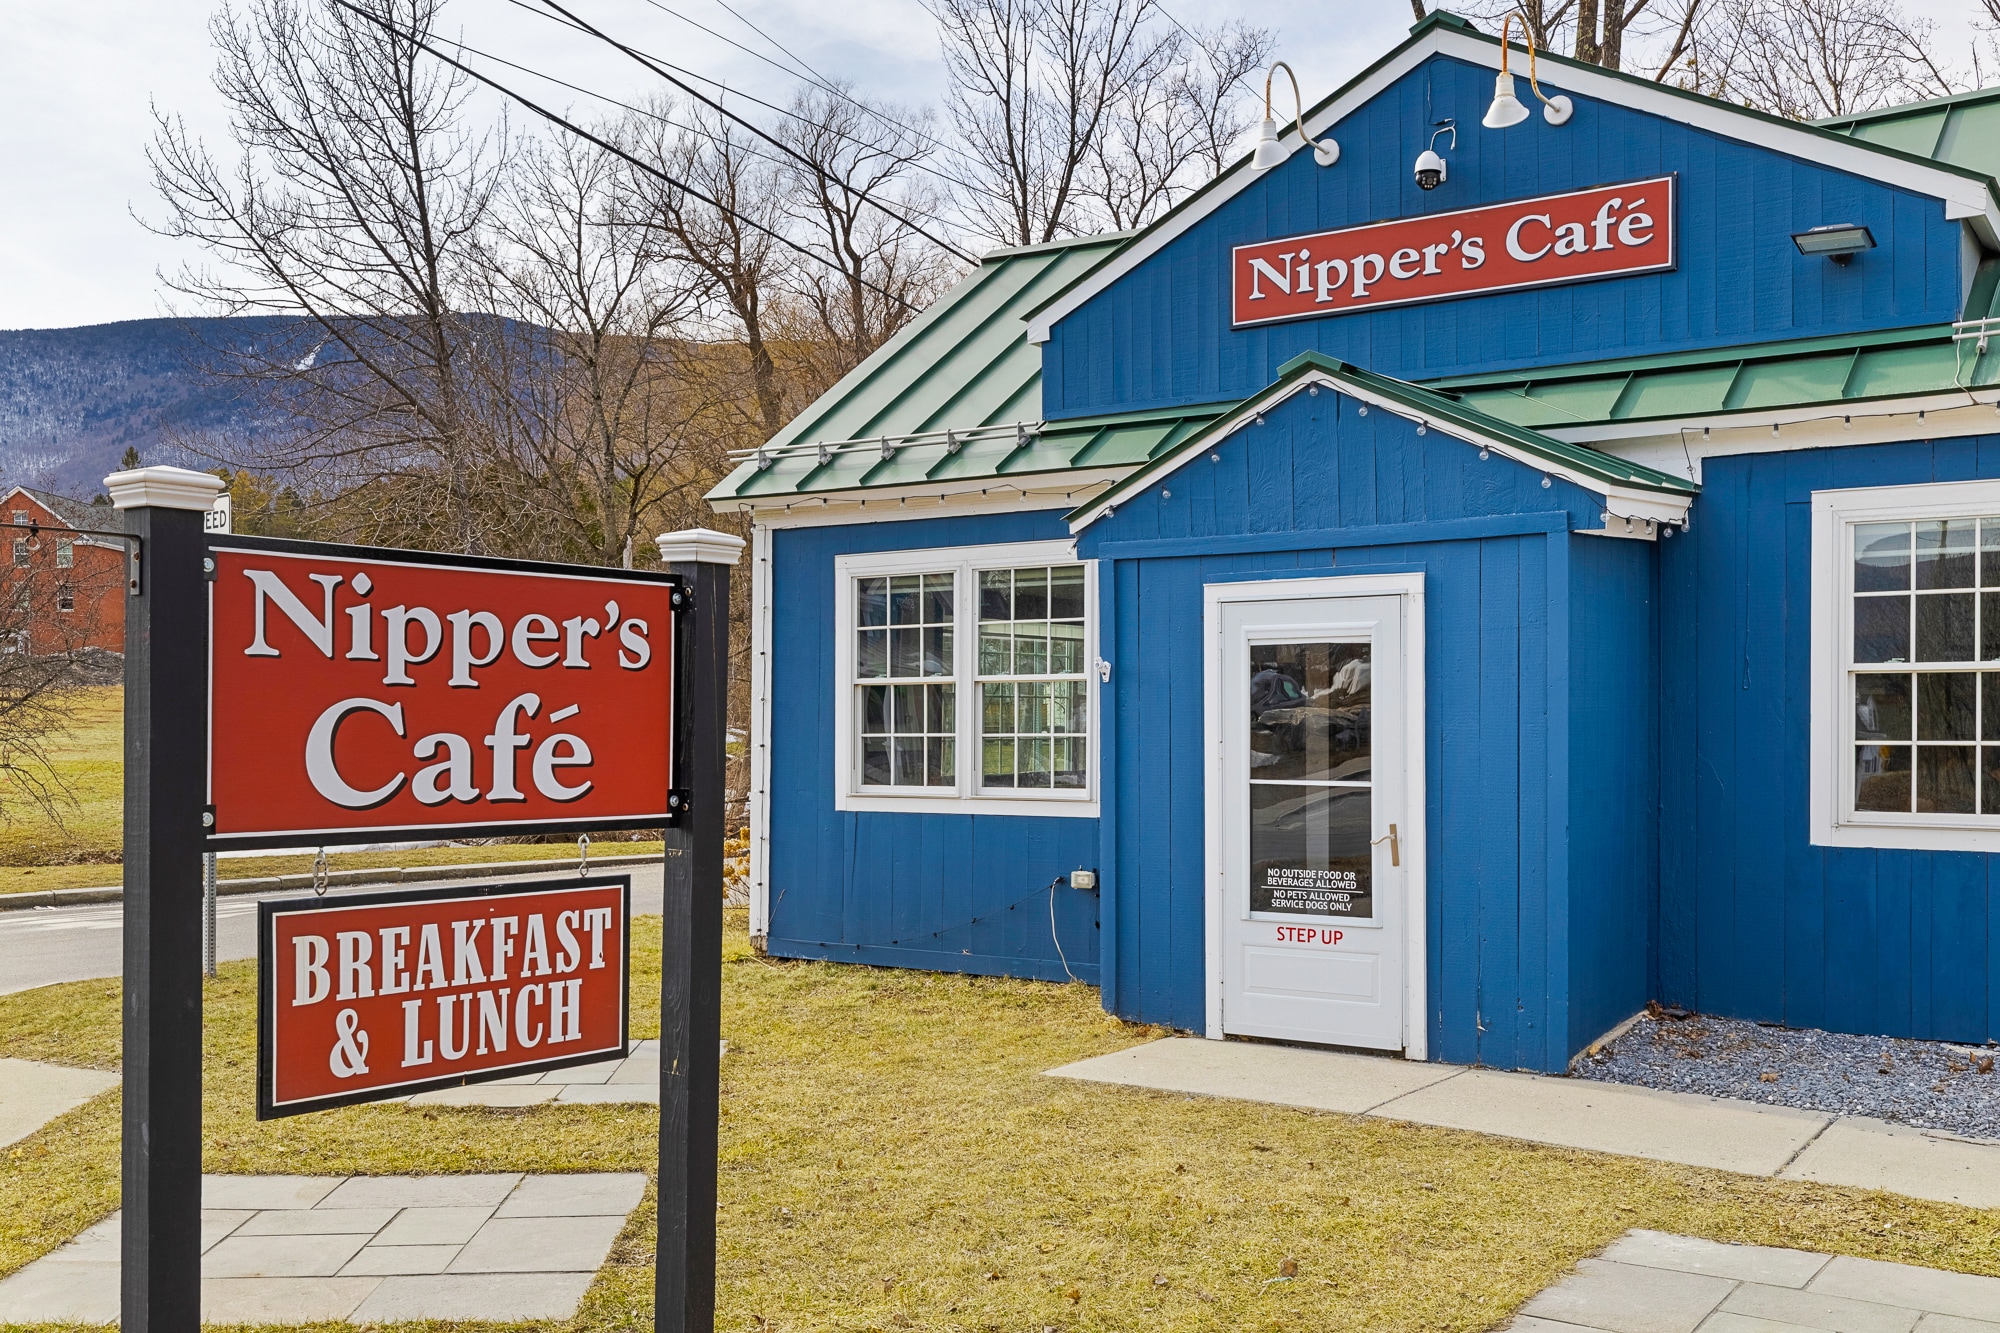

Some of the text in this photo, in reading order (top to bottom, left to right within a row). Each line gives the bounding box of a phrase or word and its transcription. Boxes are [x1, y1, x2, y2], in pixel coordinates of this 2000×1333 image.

[1248, 196, 1655, 303] Nipper's Café
[205, 509, 227, 530] EED
[242, 569, 652, 688] Nipper's
[304, 692, 594, 809] Café
[1267, 868, 1356, 880] NO OUTSIDE FOOD OR
[1267, 877, 1357, 889] BEVERAGES ALLOWED
[1271, 899, 1352, 911] SERVICE DOGS ONLY
[1273, 890, 1350, 901] NO PETS ALLOWED
[1277, 926, 1344, 945] STEP UP
[292, 907, 612, 1007] BREAKFAST
[329, 978, 583, 1078] & LUNCH
